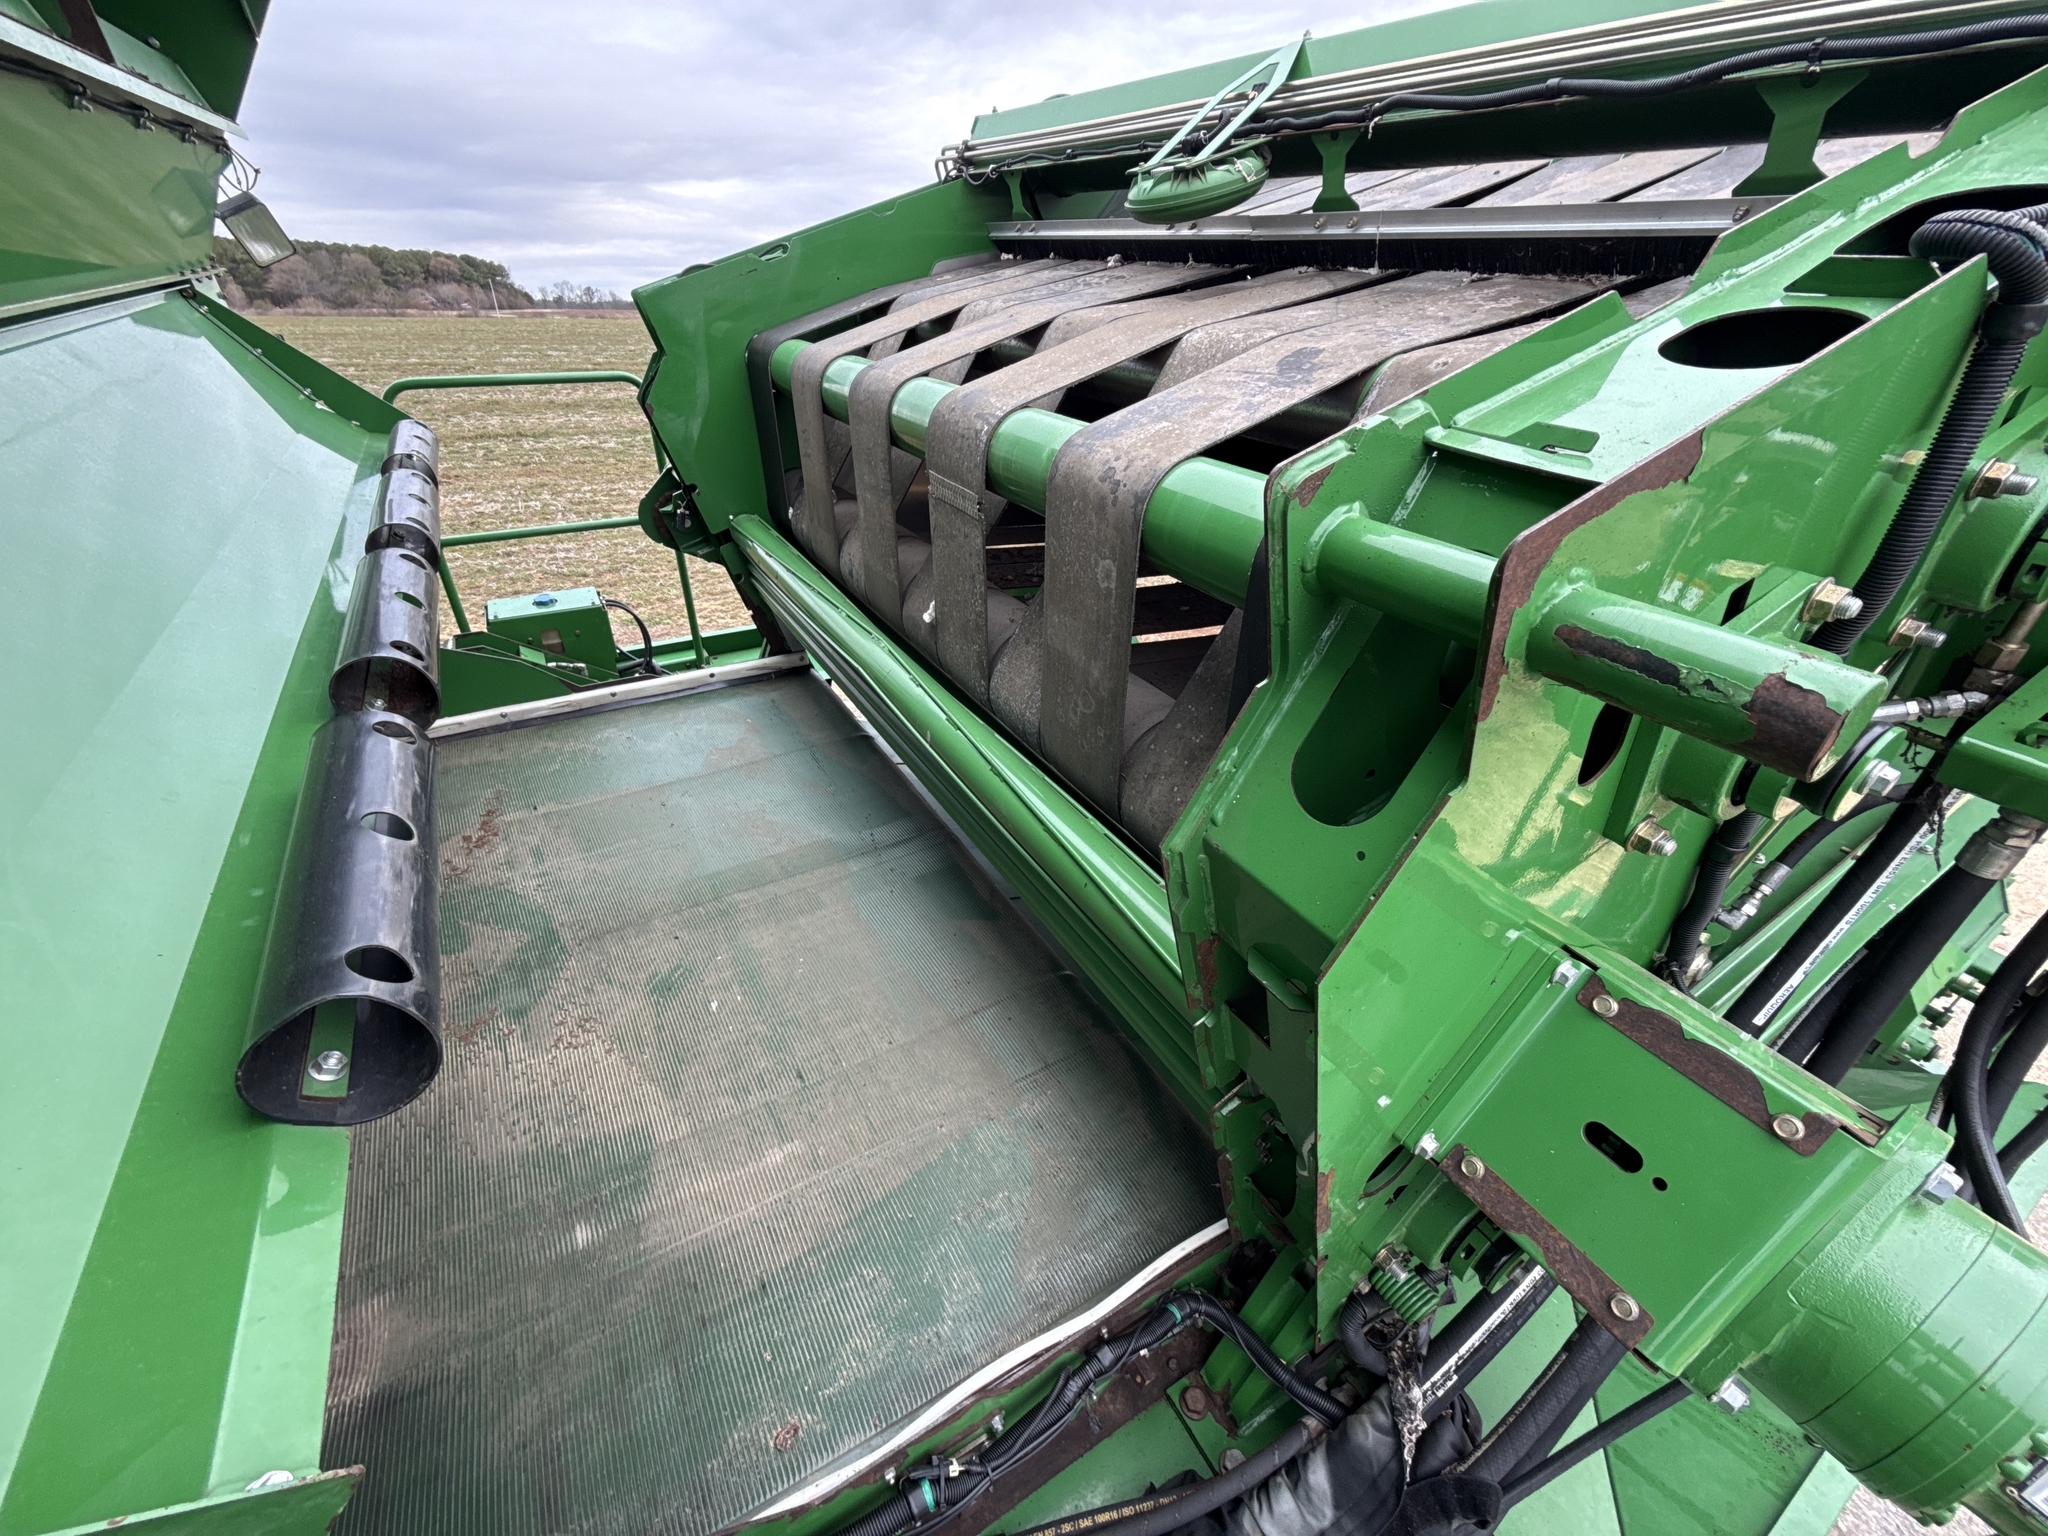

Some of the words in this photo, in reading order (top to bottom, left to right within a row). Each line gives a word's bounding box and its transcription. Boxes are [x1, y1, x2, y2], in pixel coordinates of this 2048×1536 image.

[1762, 983, 1795, 1020] AEROQUIP
[1061, 1522, 1075, 1534] 2SC
[1079, 1516, 1094, 1528] SAE
[1094, 1510, 1118, 1524] 100R16
[1122, 1506, 1134, 1516] ISO
[1136, 1500, 1154, 1513] 11237
